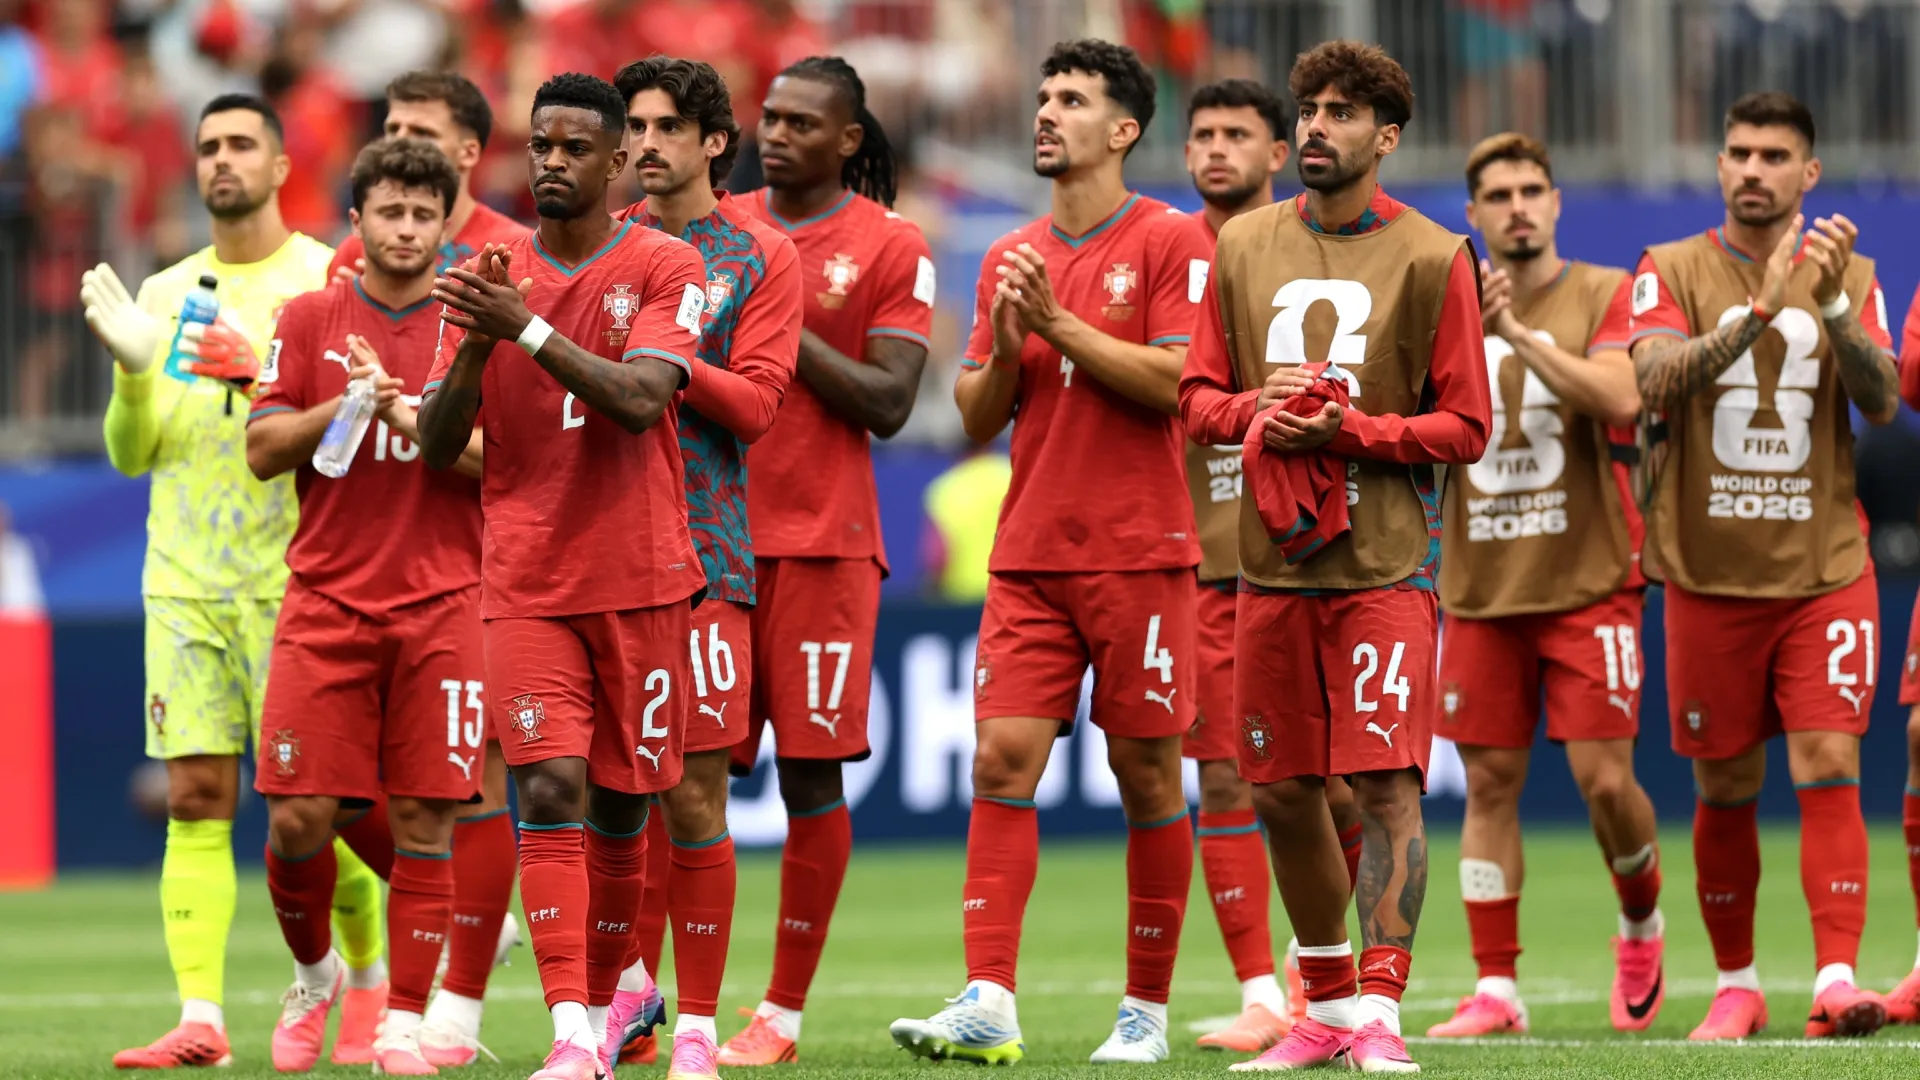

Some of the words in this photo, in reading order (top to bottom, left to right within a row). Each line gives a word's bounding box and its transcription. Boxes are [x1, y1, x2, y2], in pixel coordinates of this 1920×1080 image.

[1496, 456, 1540, 476] FIFA
[1743, 438, 1790, 455] FIFA
[1467, 495, 1532, 515] WORLD
[1533, 490, 1568, 509] CUP
[1708, 492, 1813, 521] 2026
[1710, 474, 1778, 493] WORLD
[1780, 476, 1813, 494] CUP
[1467, 508, 1568, 542] 2026
[690, 622, 736, 698] 16
[800, 641, 852, 710] 17
[1143, 615, 1174, 684] 4
[1353, 641, 1410, 713] 24
[1594, 624, 1640, 690] 18
[1826, 618, 1875, 686] 21
[440, 679, 484, 748] 15
[641, 668, 670, 739] 2
